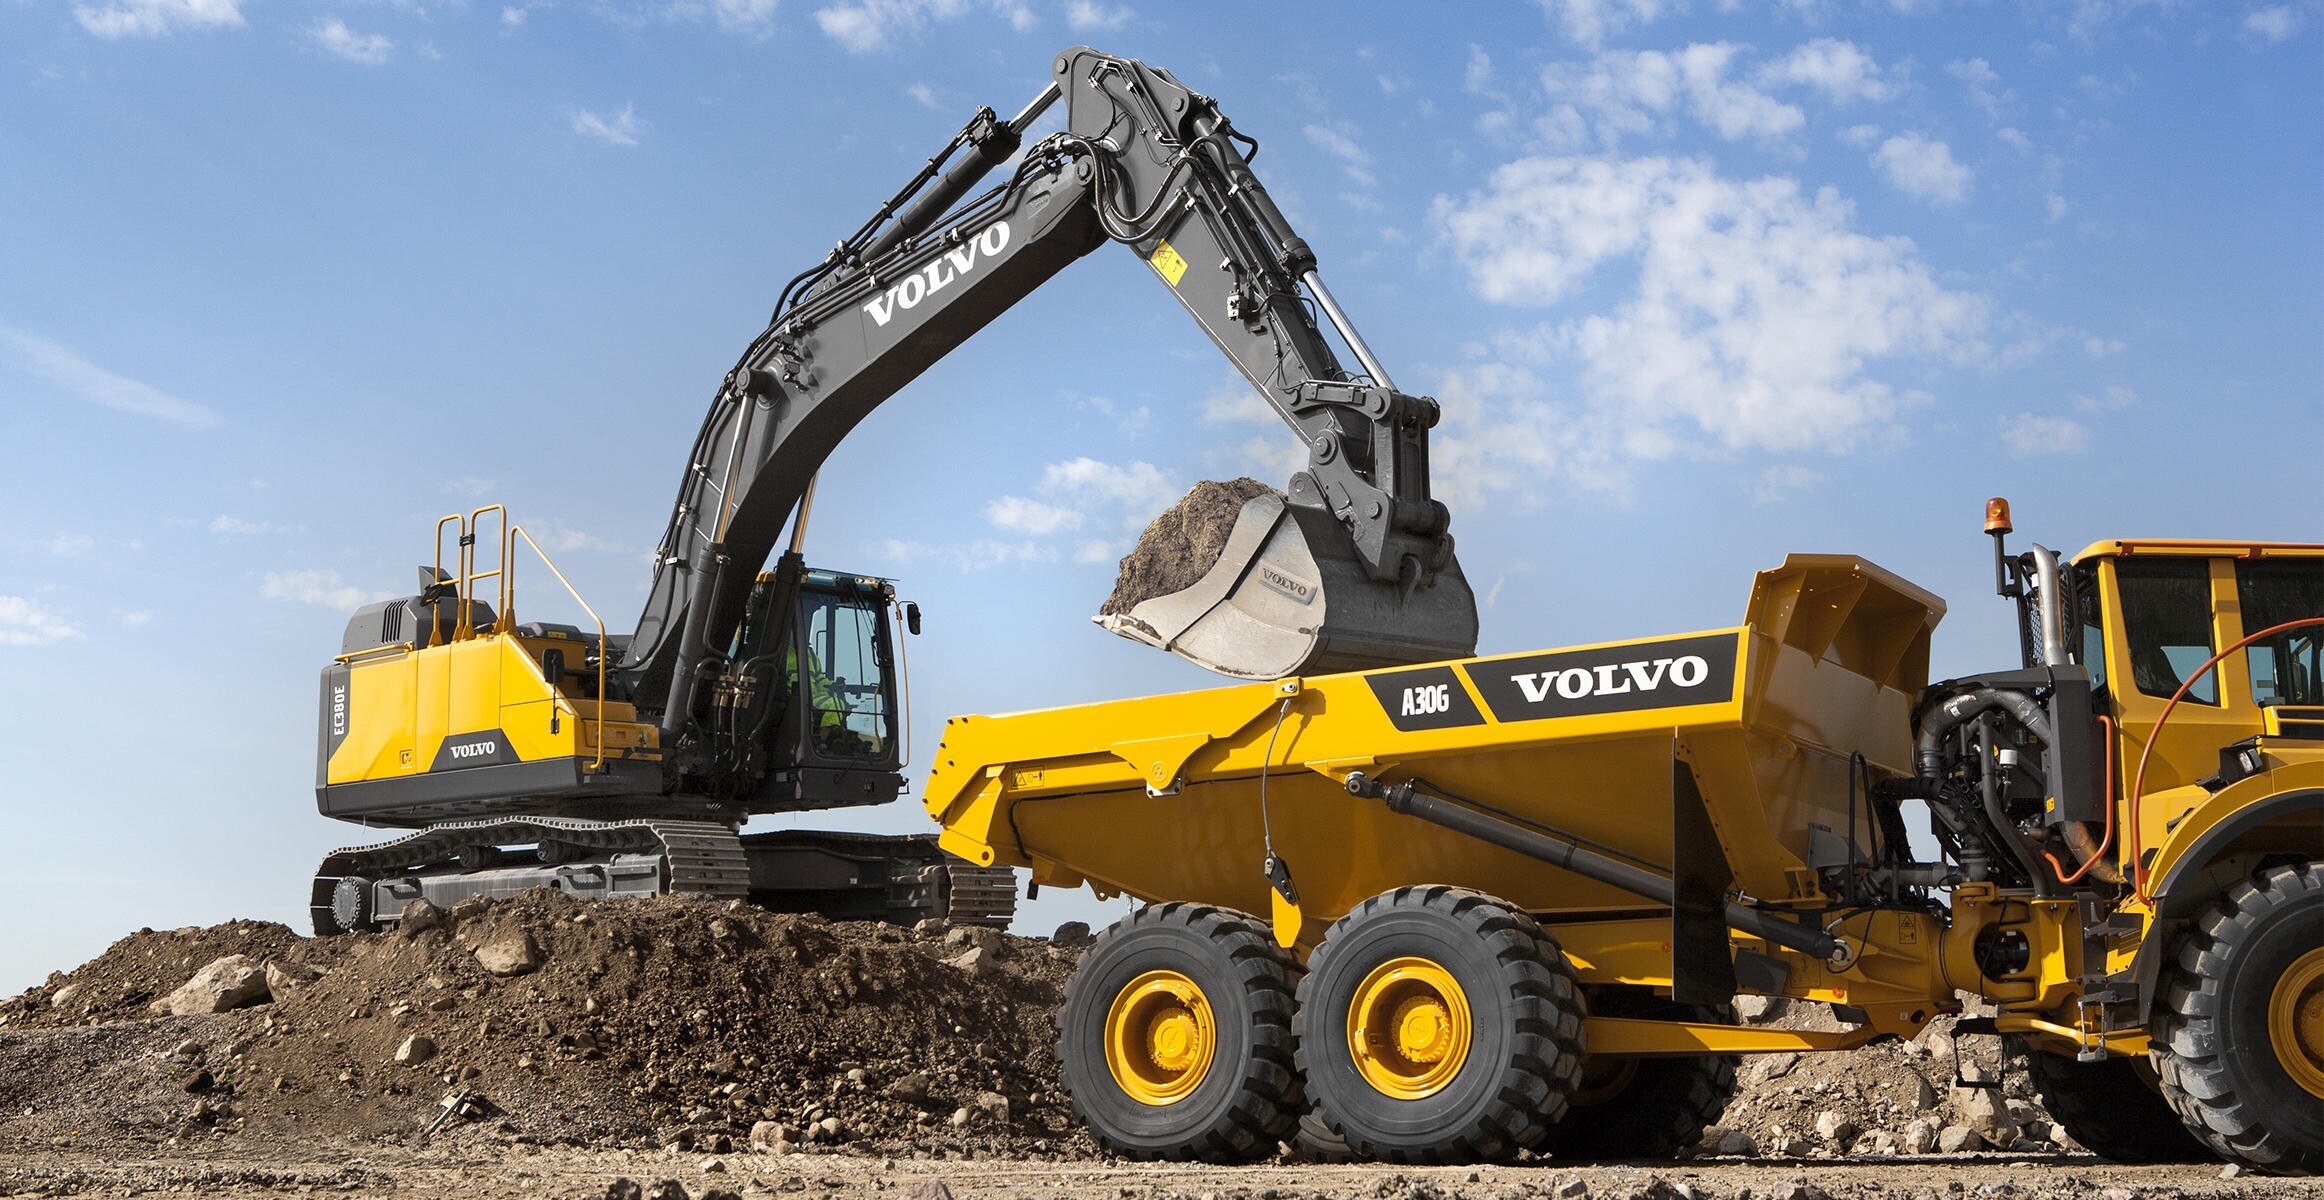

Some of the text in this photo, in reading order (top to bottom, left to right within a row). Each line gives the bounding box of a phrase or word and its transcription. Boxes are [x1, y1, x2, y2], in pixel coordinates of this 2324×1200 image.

[863, 220, 1011, 328] VOLVO
[1263, 567, 1308, 596] VOLVO
[334, 684, 346, 736] EC380E
[1401, 655, 1709, 717] A30G VOLVO
[450, 741, 496, 759] VOLVO
